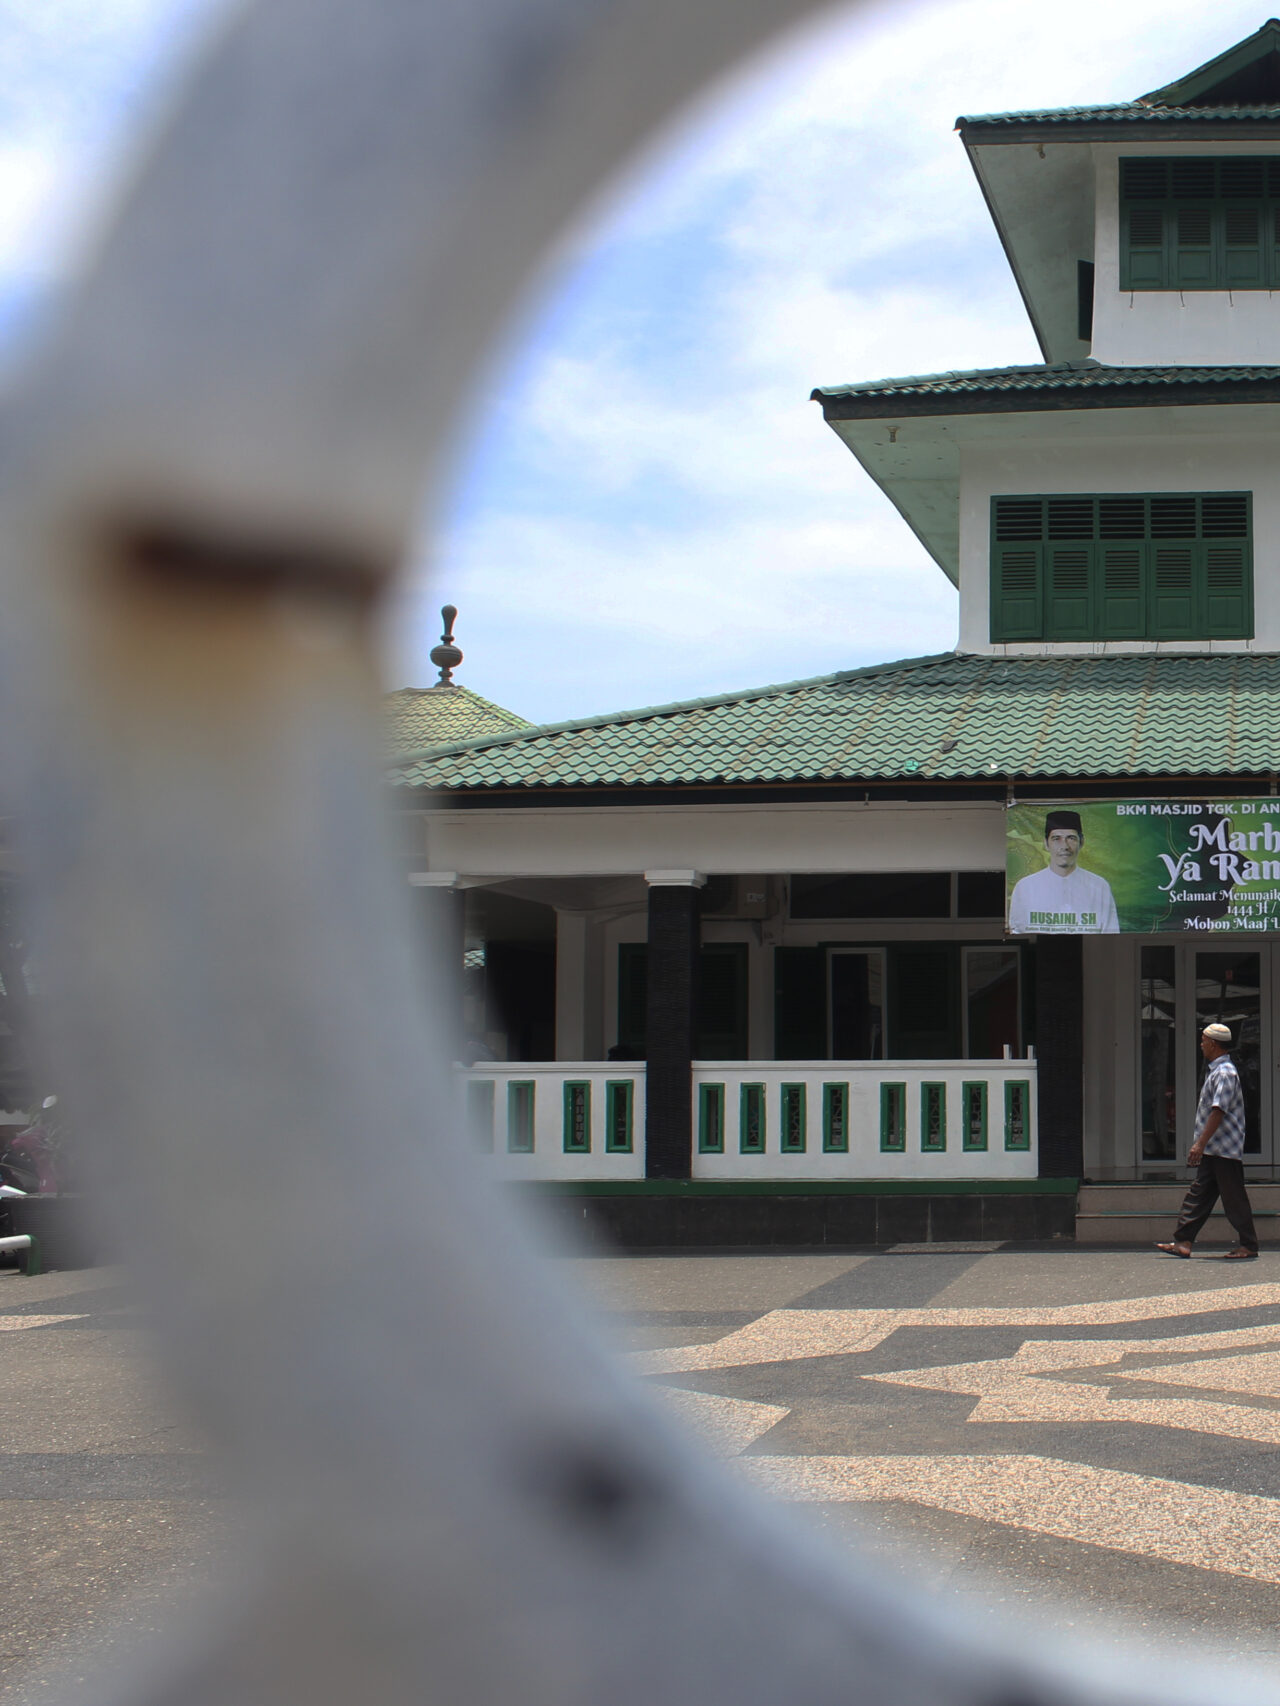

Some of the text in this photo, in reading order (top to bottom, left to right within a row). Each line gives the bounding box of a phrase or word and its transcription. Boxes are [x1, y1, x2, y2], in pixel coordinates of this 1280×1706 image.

[1116, 804, 1147, 816] BKM
[1150, 804, 1203, 816] MASJID
[1206, 803, 1237, 815] TGK.
[1241, 803, 1256, 814] DI
[1157, 852, 1202, 891] Ya
[1169, 889, 1218, 903] Selamat
[1227, 905, 1254, 917] 1444
[1255, 900, 1270, 916] H
[1271, 901, 1278, 914] /
[1029, 911, 1097, 926] HUSAINI, SH
[1183, 915, 1231, 930] Mohon
[1233, 915, 1270, 932] Maaf
